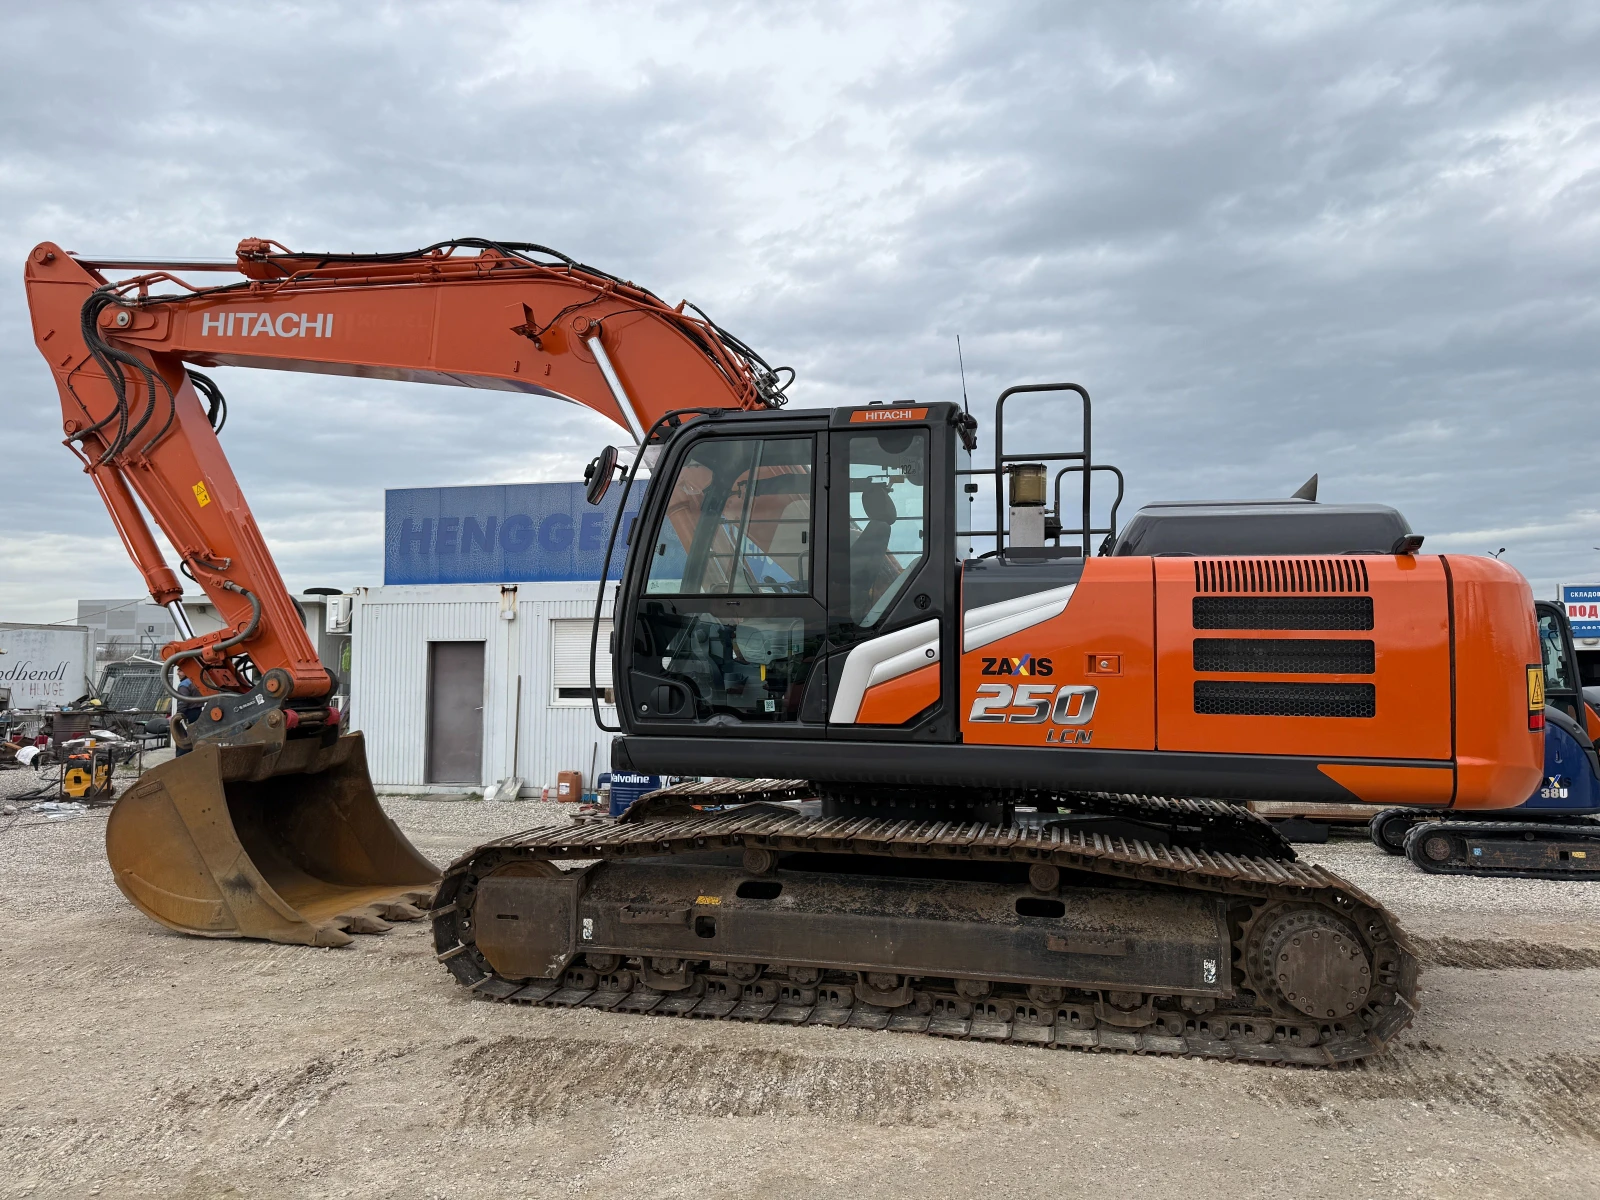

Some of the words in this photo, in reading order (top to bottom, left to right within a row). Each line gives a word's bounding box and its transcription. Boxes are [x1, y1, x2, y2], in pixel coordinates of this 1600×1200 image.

[201, 312, 334, 338] HITACHI
[865, 410, 912, 420] HITACHI
[1568, 604, 1599, 619] ПОД
[981, 653, 1054, 676] ZAXIS
[968, 683, 1099, 726] 250
[1045, 728, 1094, 745] LCN
[1540, 788, 1569, 799] 38U
